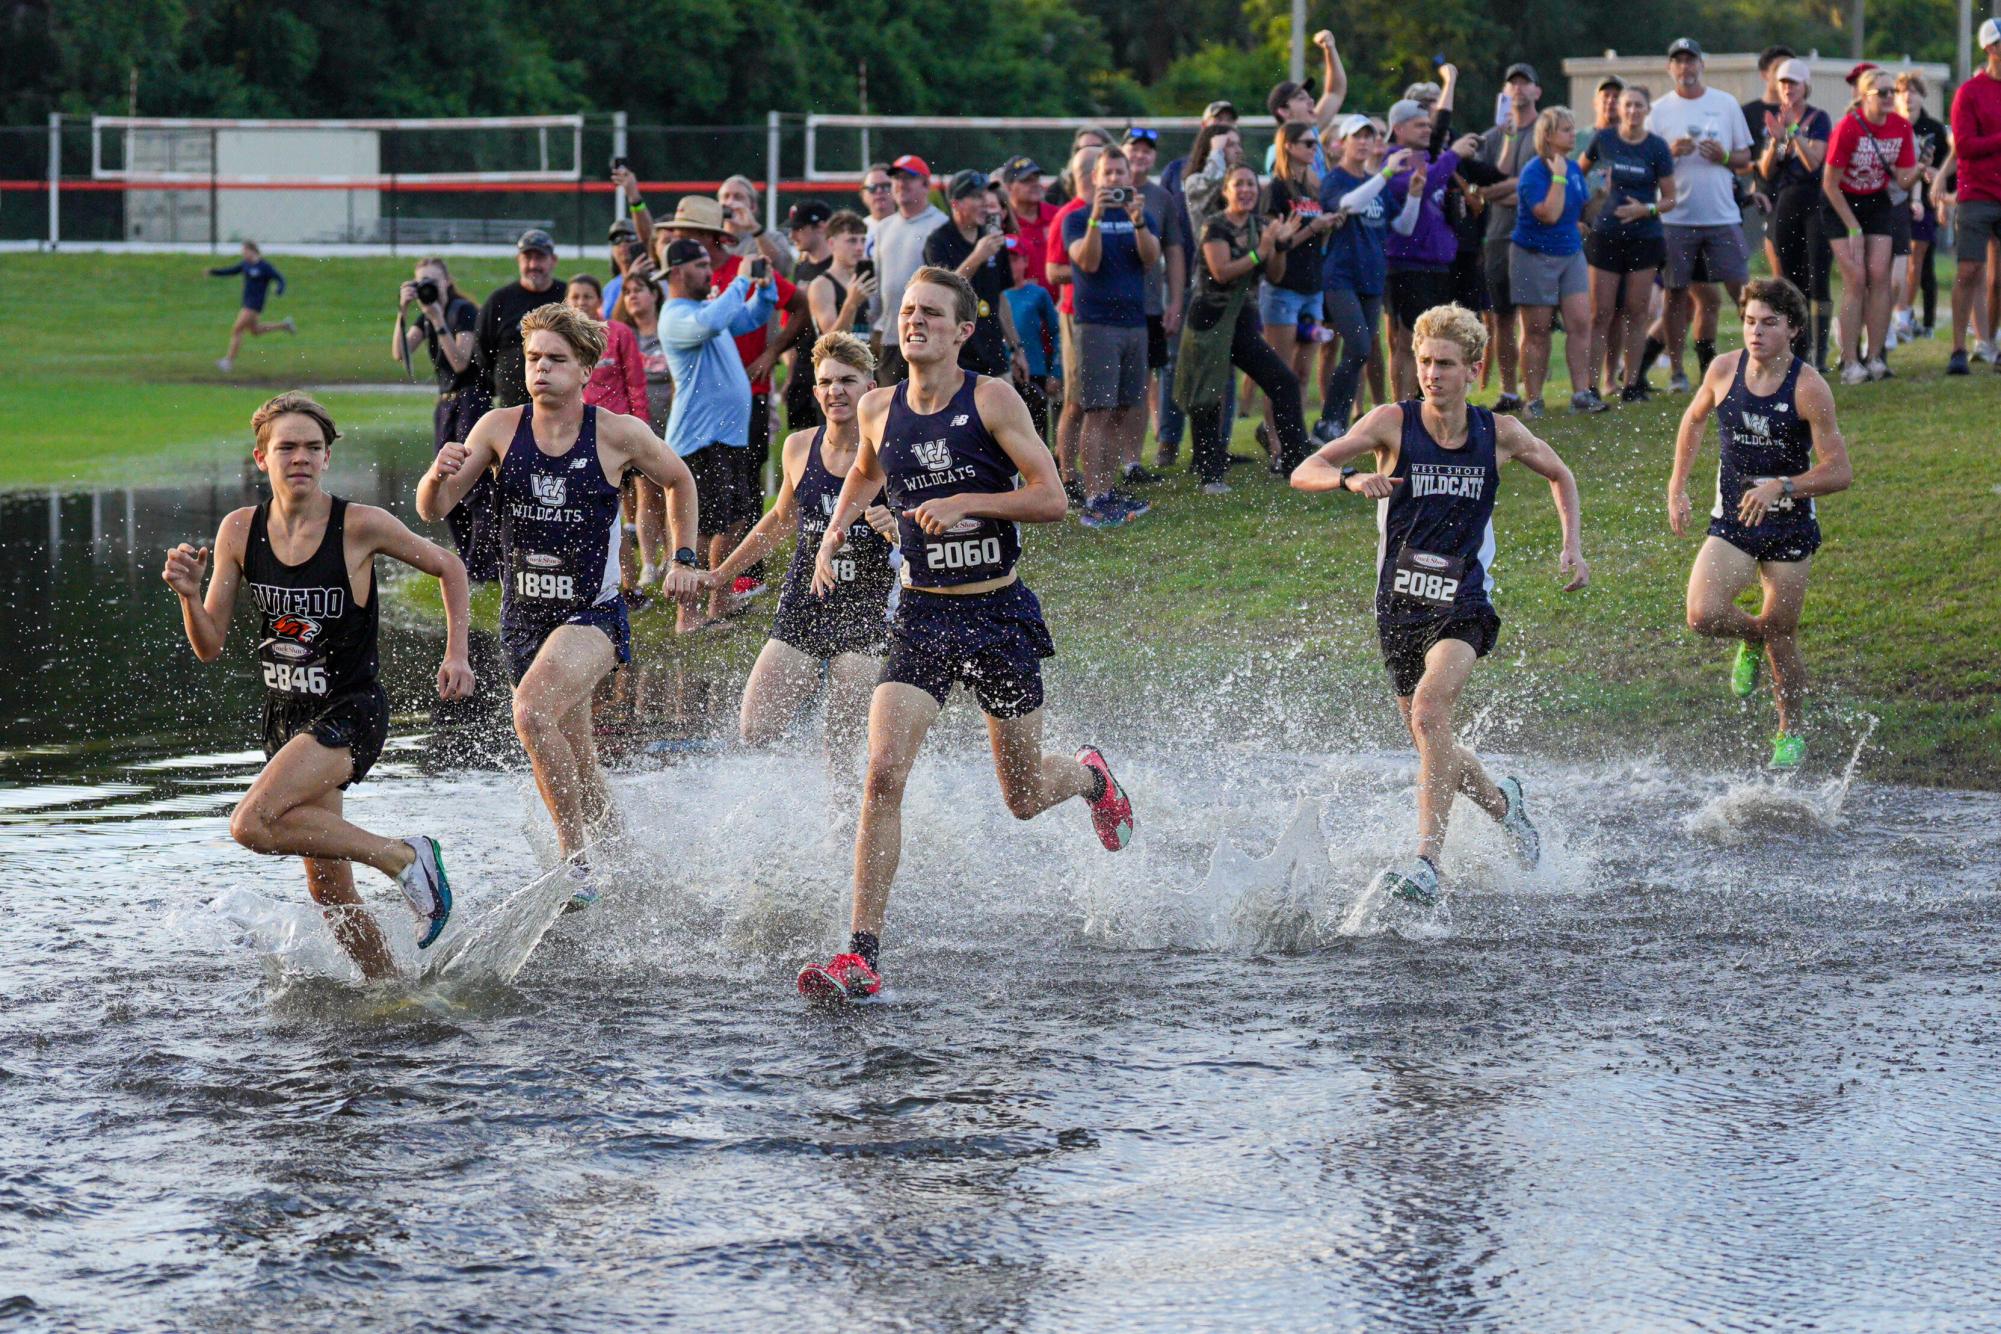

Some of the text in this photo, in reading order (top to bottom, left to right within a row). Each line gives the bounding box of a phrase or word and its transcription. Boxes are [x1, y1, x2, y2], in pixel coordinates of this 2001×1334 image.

[904, 465, 976, 492] WILDCATS
[1412, 464, 1485, 475] WEST SHORE
[1411, 475, 1485, 501] WILDCATS
[511, 503, 583, 522] WILDCATS
[926, 537, 1000, 569] 2060
[516, 572, 574, 600] 1898
[1394, 569, 1458, 602] 2082
[250, 583, 344, 618] OVIEDO
[262, 661, 327, 694] 2846
